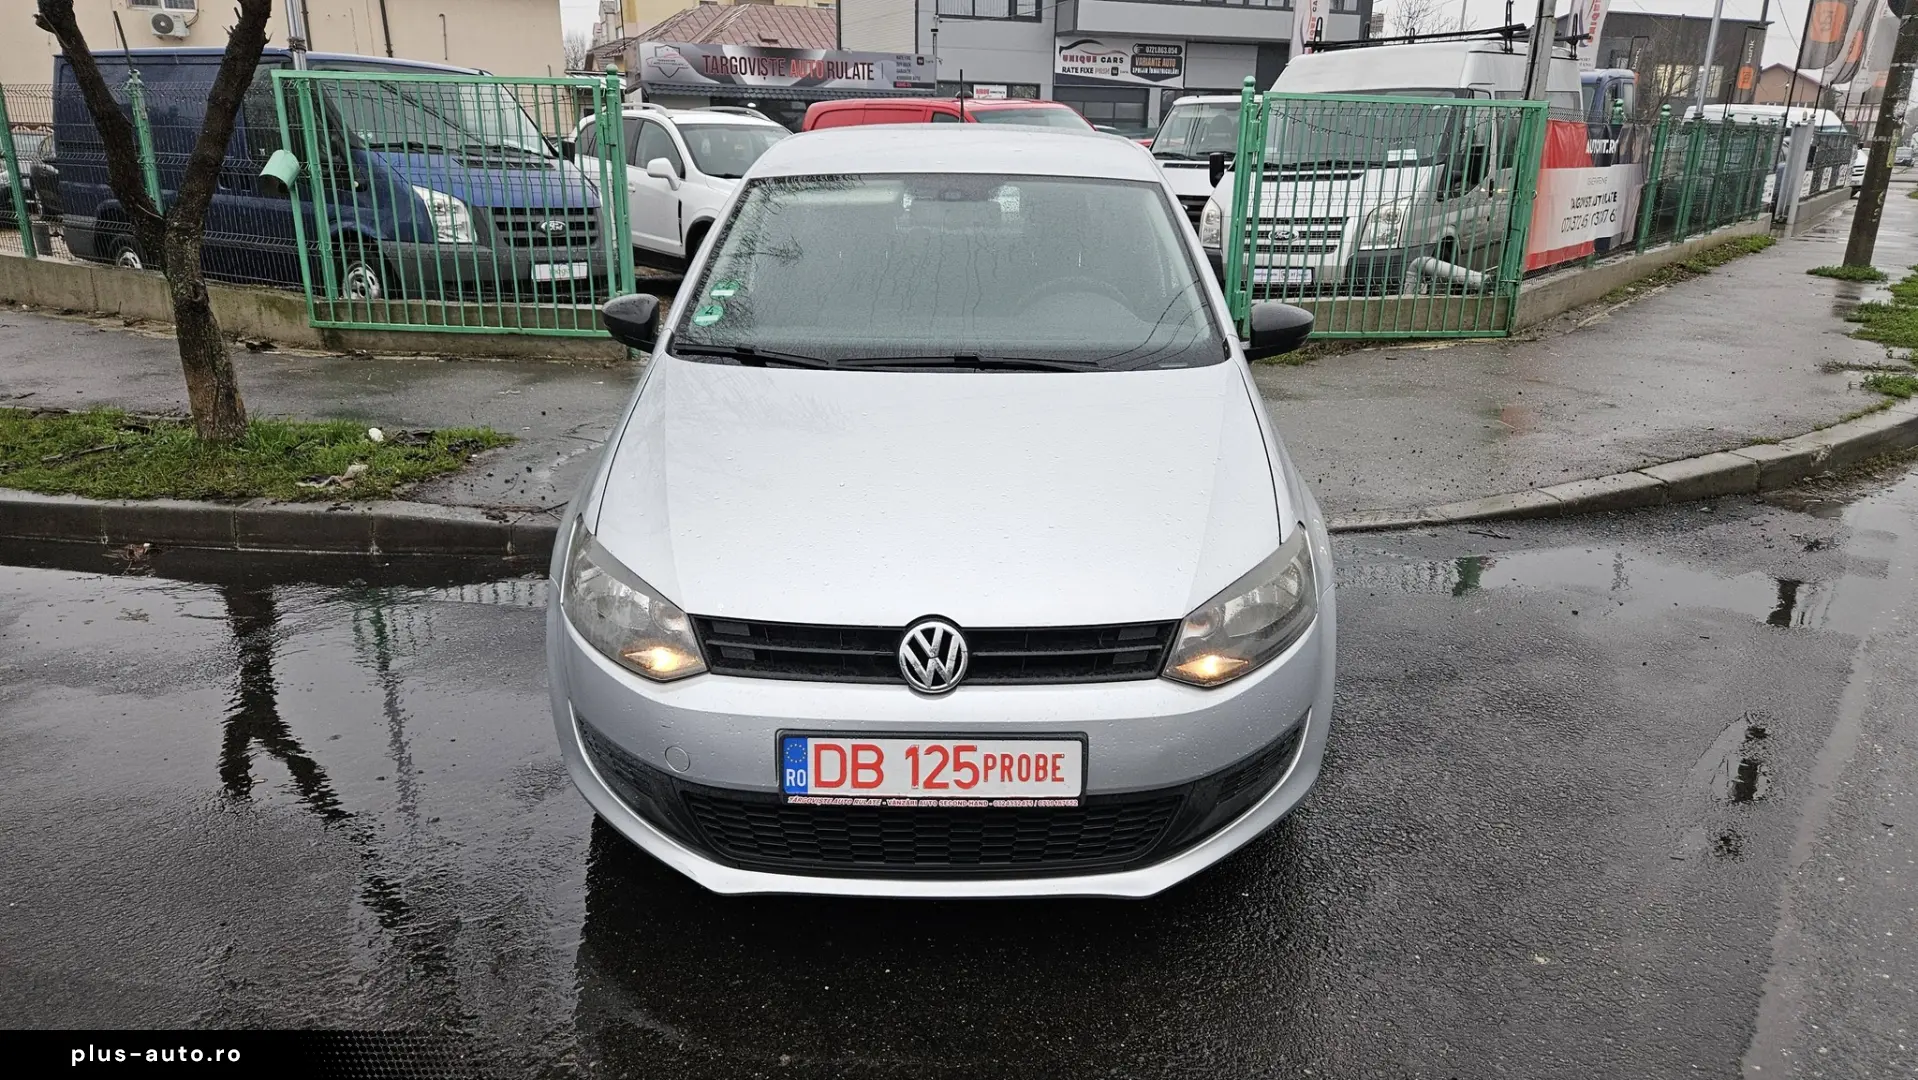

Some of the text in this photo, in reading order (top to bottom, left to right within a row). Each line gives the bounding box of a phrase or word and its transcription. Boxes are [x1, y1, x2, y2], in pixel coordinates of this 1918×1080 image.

[1062, 54, 1097, 64] UNIQUE
[1162, 58, 1176, 67] AUTO
[789, 58, 825, 78] AUTO
[827, 61, 875, 80] RULATE
[1061, 66, 1079, 74] RATE
[901, 624, 965, 690] VW
[786, 743, 1065, 790] RO DB 125 PROBE
[832, 798, 853, 806] AUTO
[853, 798, 882, 806] RULATE
[918, 799, 938, 807] AUTO
